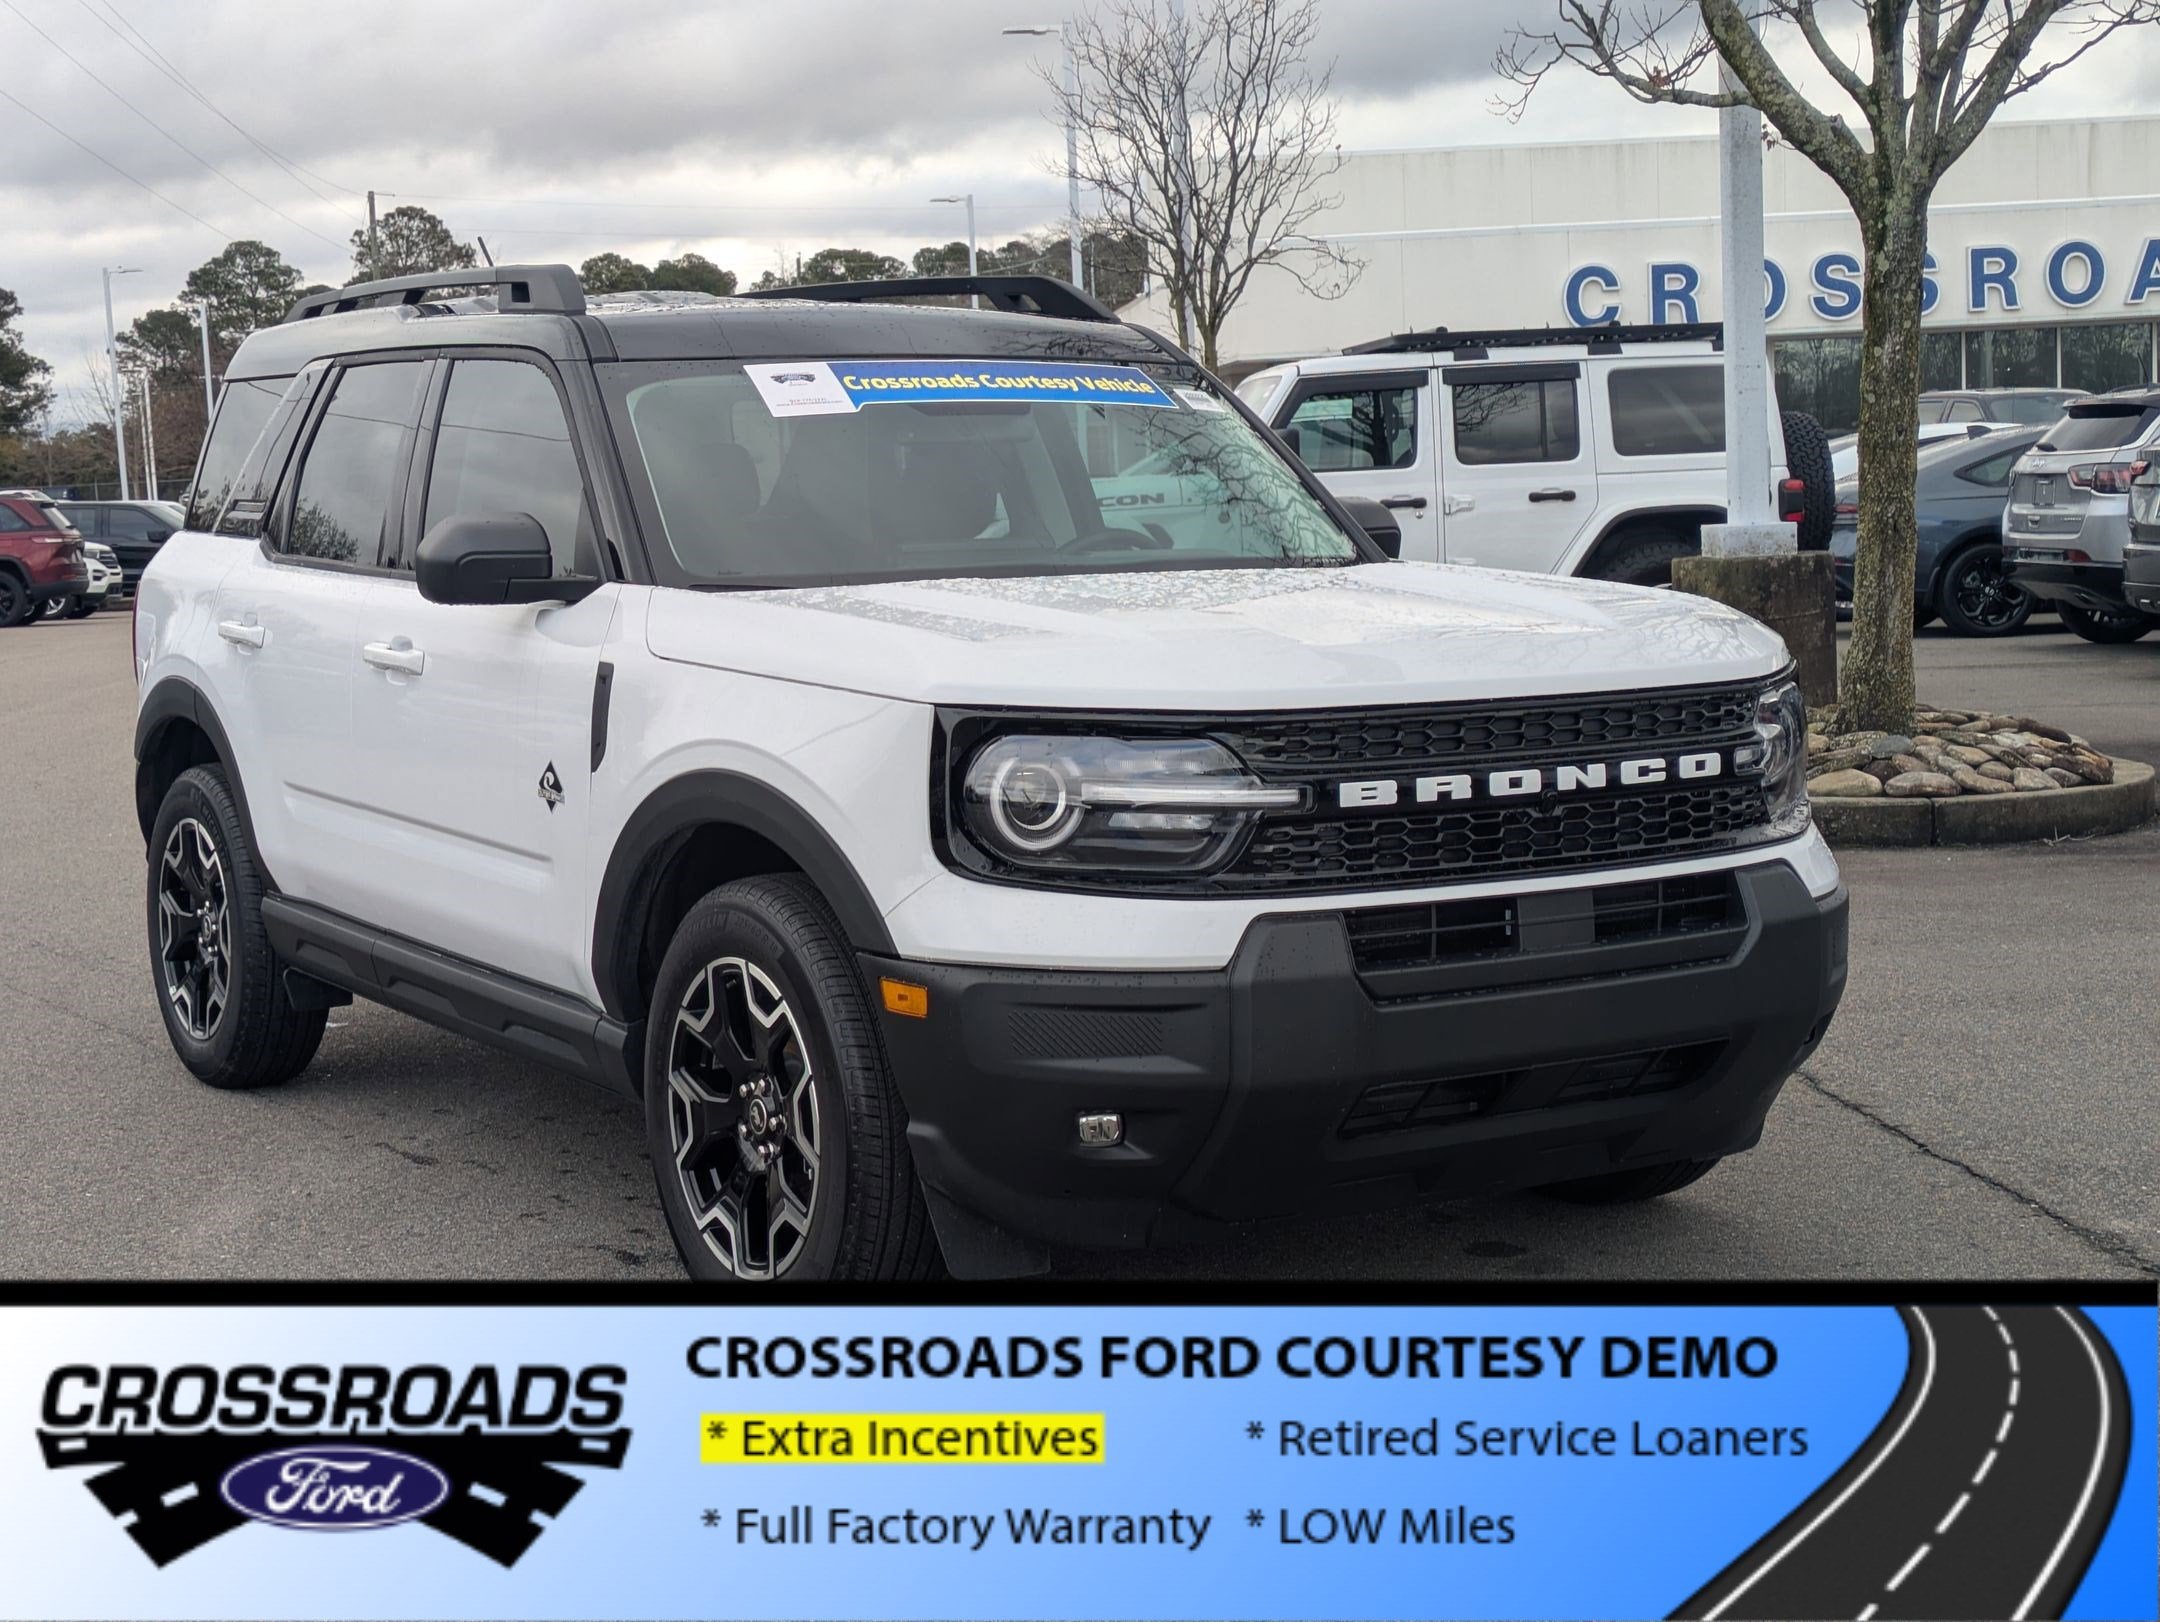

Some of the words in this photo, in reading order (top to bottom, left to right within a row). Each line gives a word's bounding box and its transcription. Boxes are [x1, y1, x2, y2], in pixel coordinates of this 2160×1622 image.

[843, 373, 979, 391] Crossroads
[980, 374, 1077, 392] Courtesy
[1077, 375, 1156, 394] Vehicle
[1339, 751, 1723, 807] BRONCO
